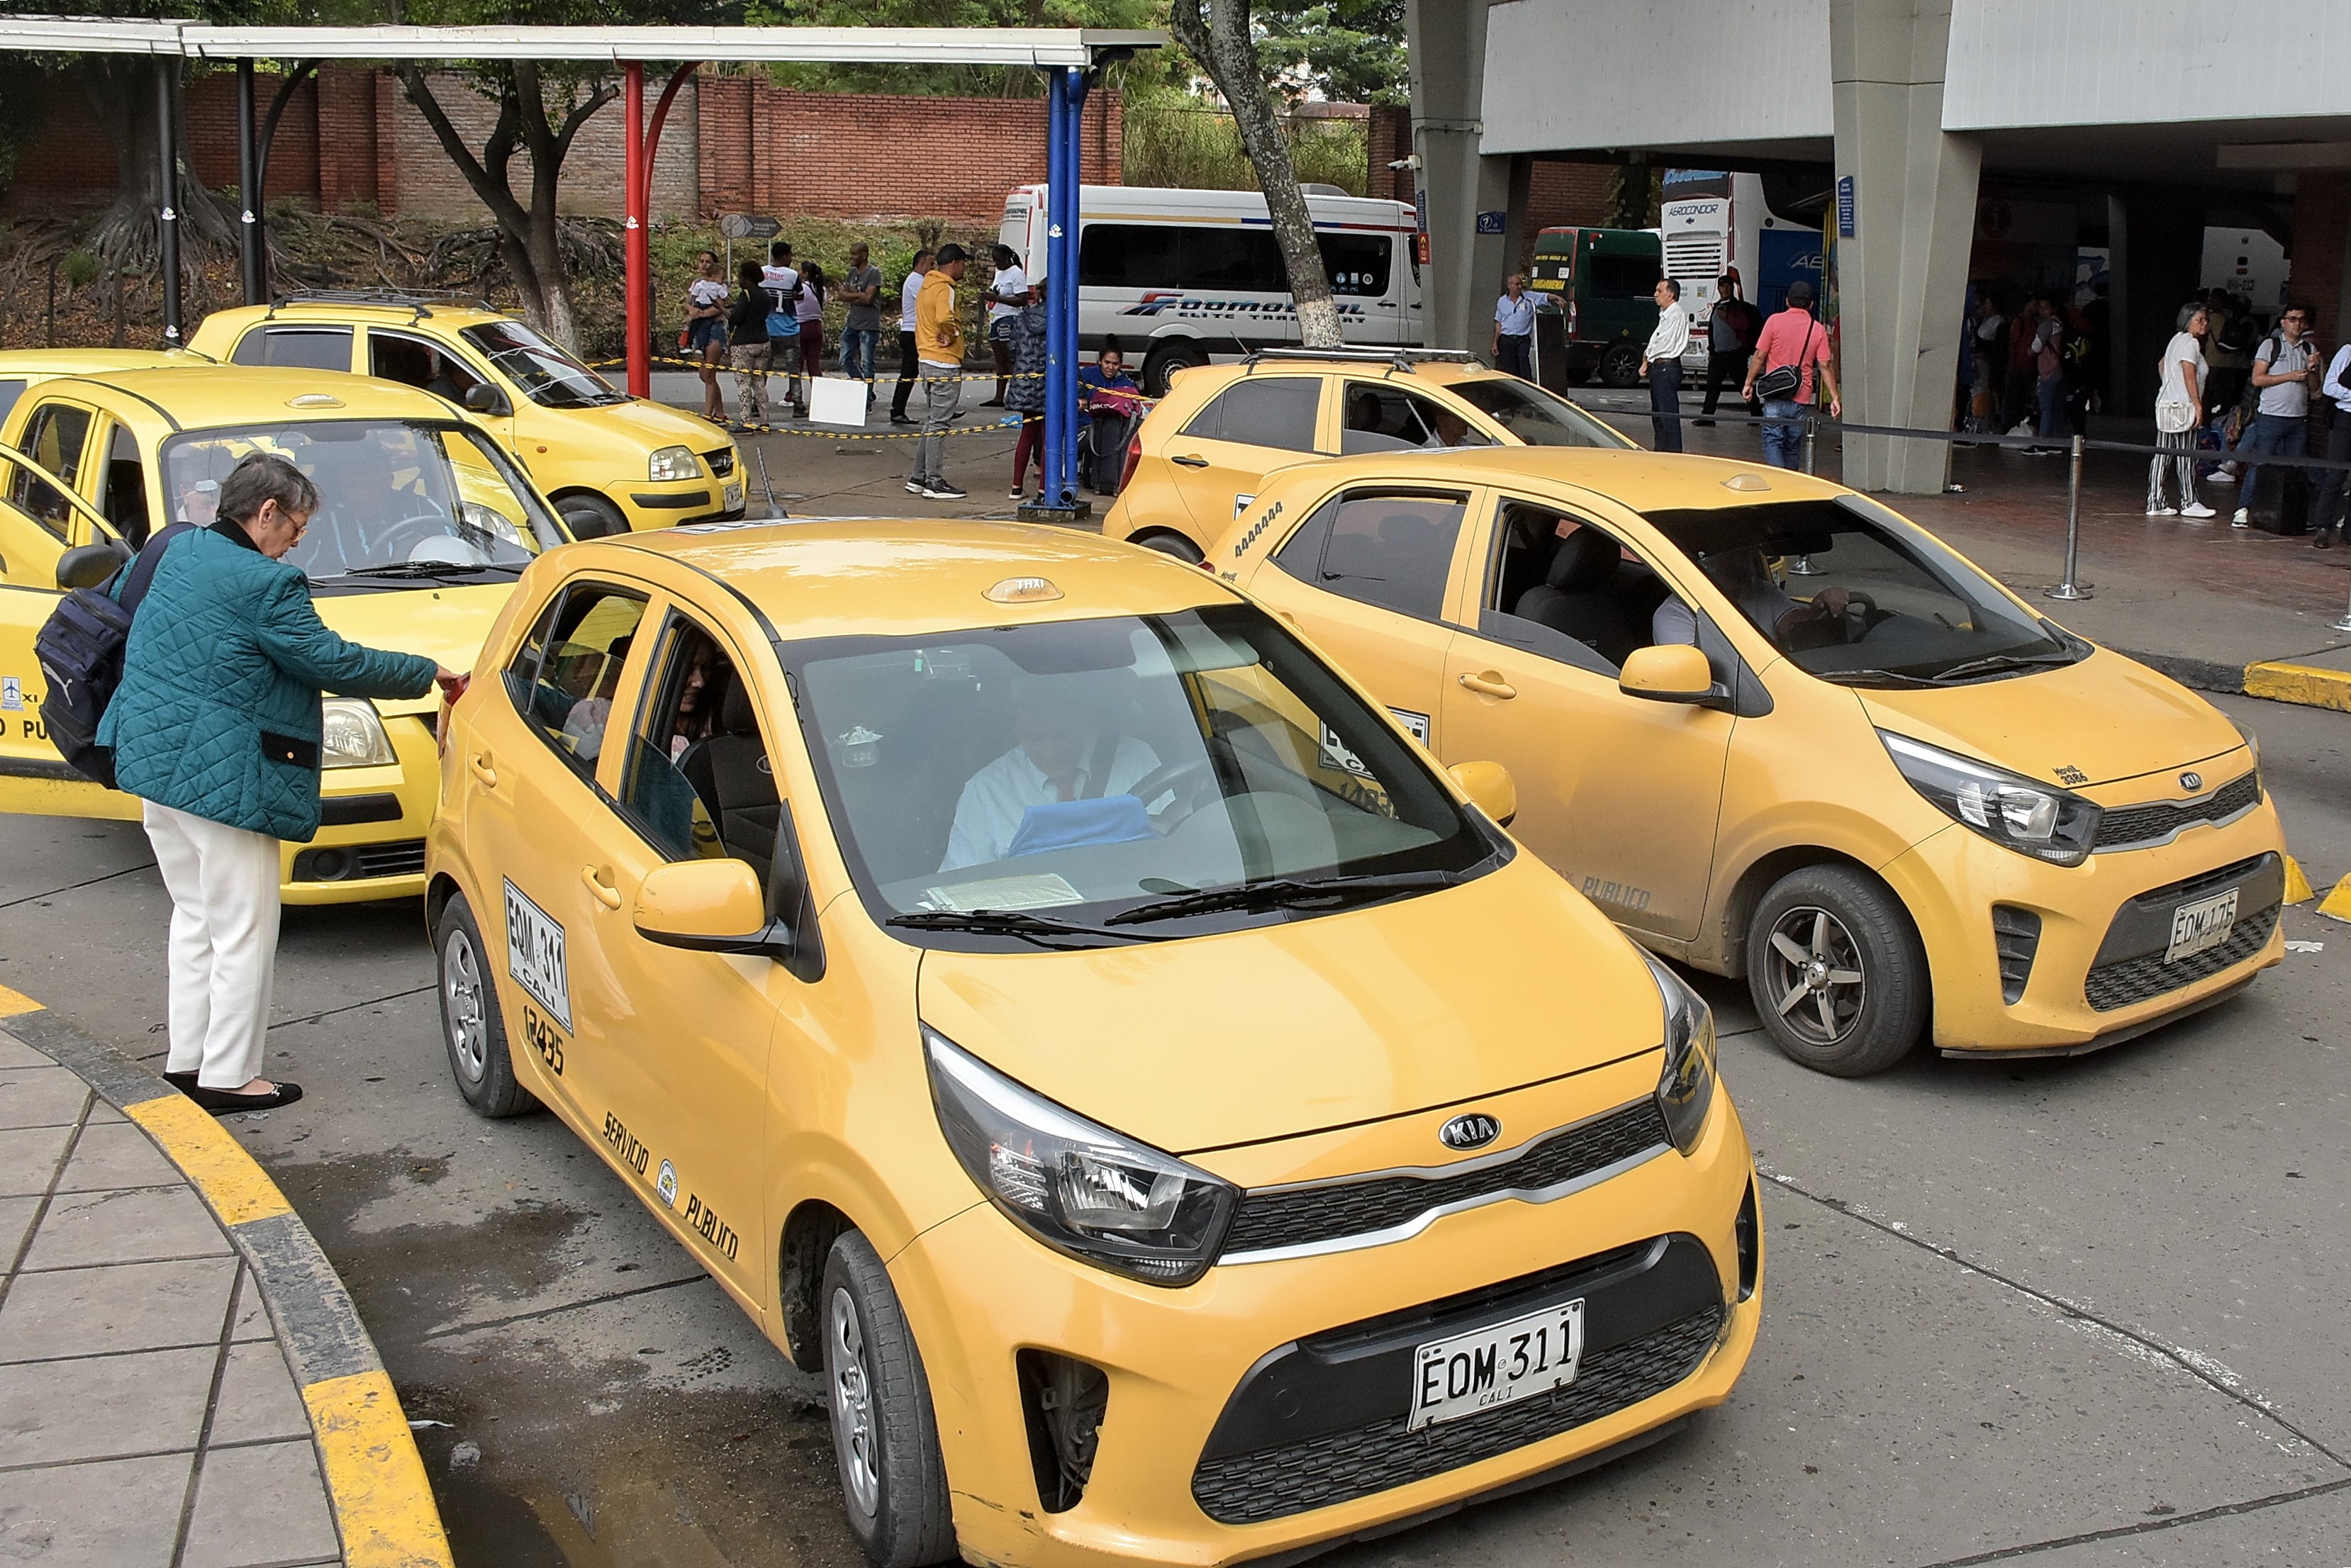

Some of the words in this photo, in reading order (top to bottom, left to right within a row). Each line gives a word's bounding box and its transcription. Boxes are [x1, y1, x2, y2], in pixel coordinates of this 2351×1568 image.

[1668, 204, 1719, 216] AEROCONDOR
[1016, 578, 1044, 590] TAXI
[2060, 772, 2089, 785] 3386
[2181, 773, 2202, 788] KIA
[2206, 899, 2235, 936] 175
[540, 926, 566, 998] 311
[523, 967, 556, 1010] CALI
[523, 1004, 564, 1077] 12435
[603, 1110, 650, 1177] SERVICIO
[1448, 1117, 1495, 1145] KIA
[684, 1192, 739, 1264] PUBLICO
[1507, 1318, 1572, 1381] 311
[1479, 1385, 1514, 1406] CALI
